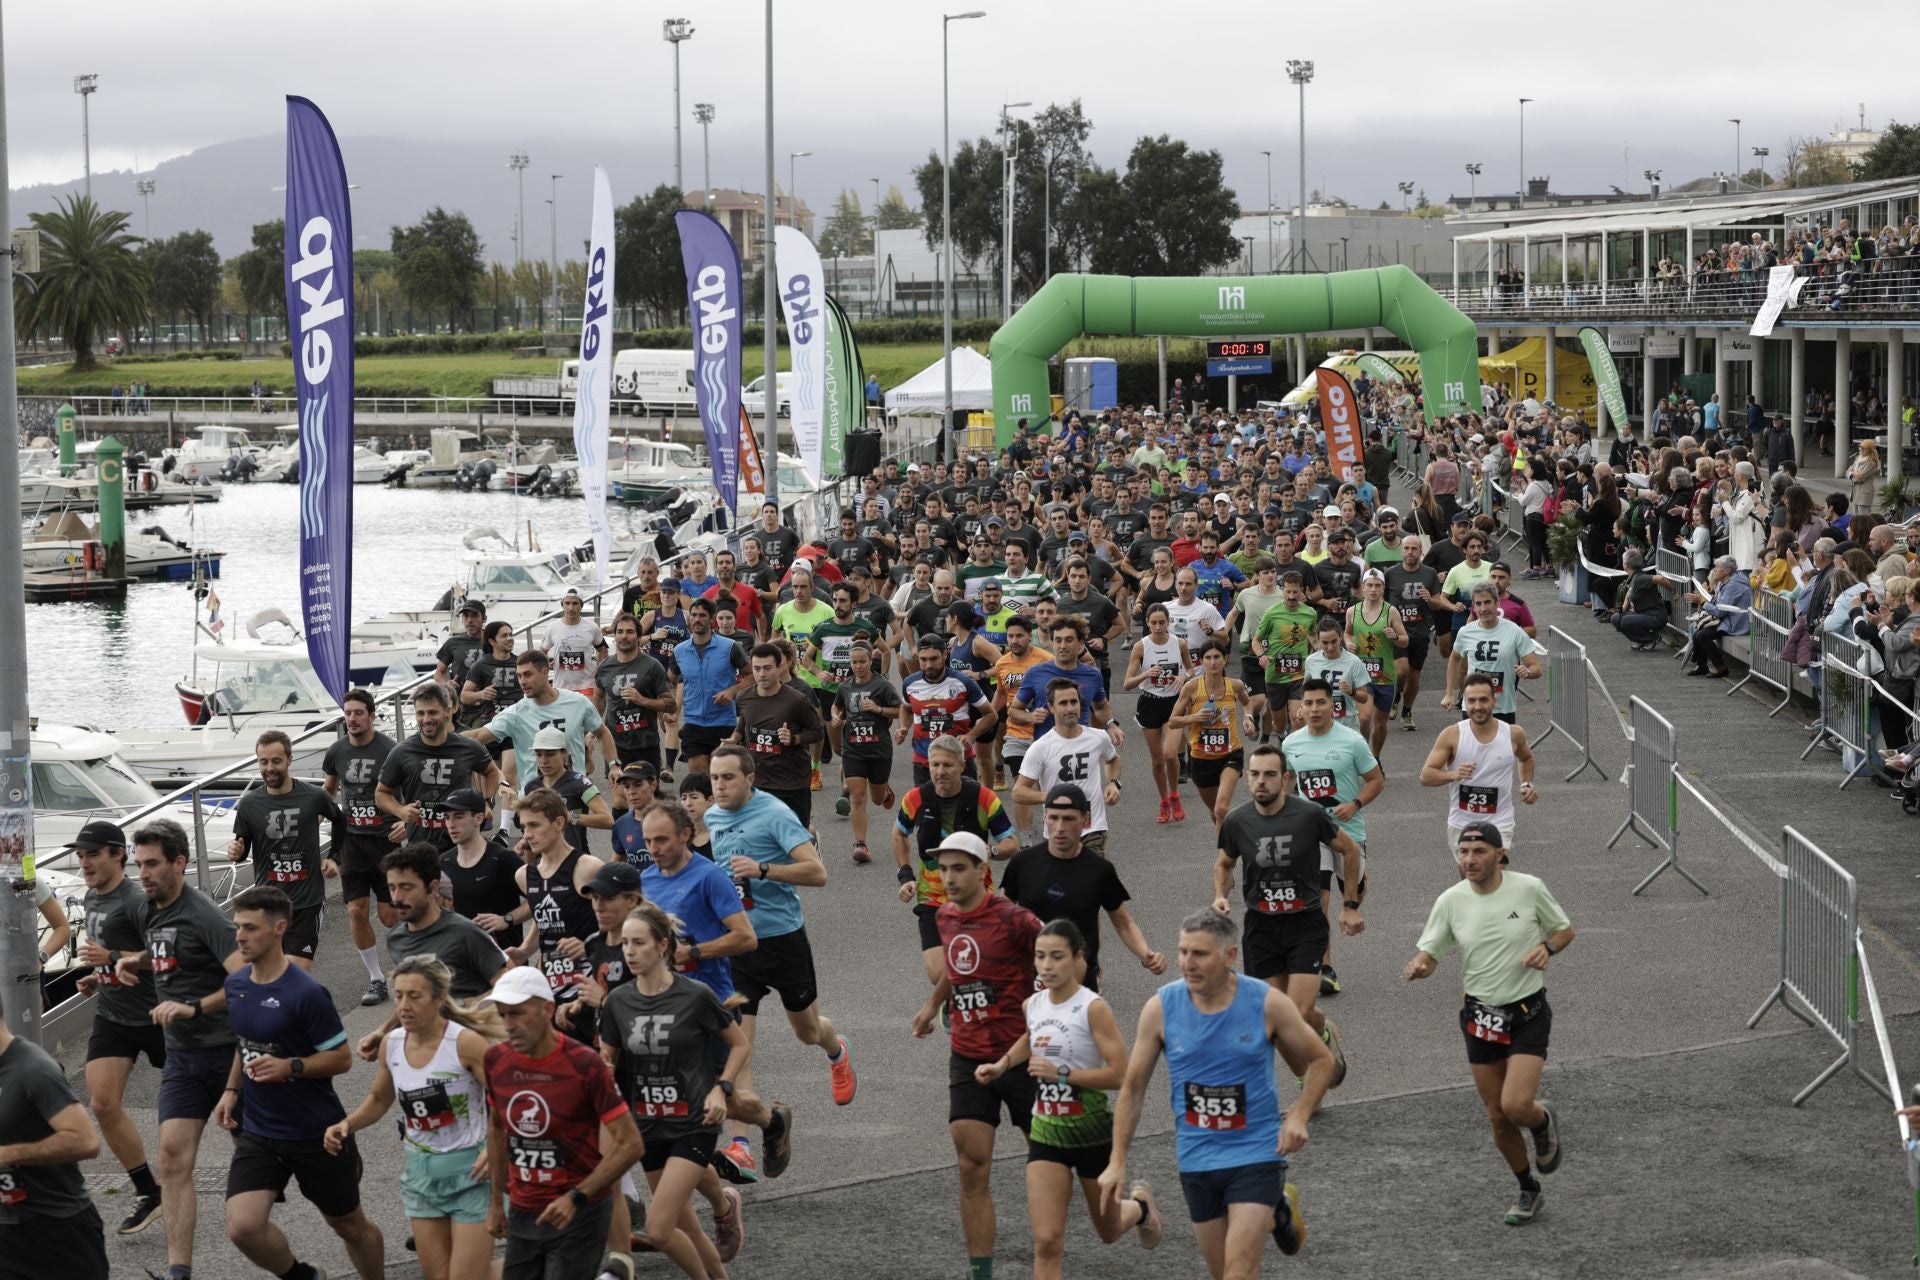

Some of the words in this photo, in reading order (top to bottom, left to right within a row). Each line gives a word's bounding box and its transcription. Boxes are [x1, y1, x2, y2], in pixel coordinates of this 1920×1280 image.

[63, 417, 73, 432] B
[101, 460, 119, 482] C
[562, 656, 582, 665] 364
[1279, 659, 1299, 667] 139
[836, 668, 849, 677] 87
[618, 713, 641, 724] 347
[853, 726, 873, 737] 131
[929, 721, 945, 731] 57
[756, 734, 772, 746] 62
[1202, 734, 1226, 746] 188
[1304, 776, 1330, 790] 130
[1469, 793, 1487, 805] 23
[351, 806, 376, 818] 326
[272, 860, 302, 873] 236
[1264, 887, 1296, 902] 348
[534, 908, 561, 922] CATT
[151, 942, 166, 959] 14
[545, 957, 574, 977] 269
[955, 992, 989, 1010] 378
[1475, 1010, 1504, 1032] 342
[641, 1086, 678, 1105] 159
[1040, 1083, 1074, 1103] 232
[412, 1100, 428, 1118] 8
[1192, 1096, 1237, 1118] 353
[514, 1149, 557, 1170] 275
